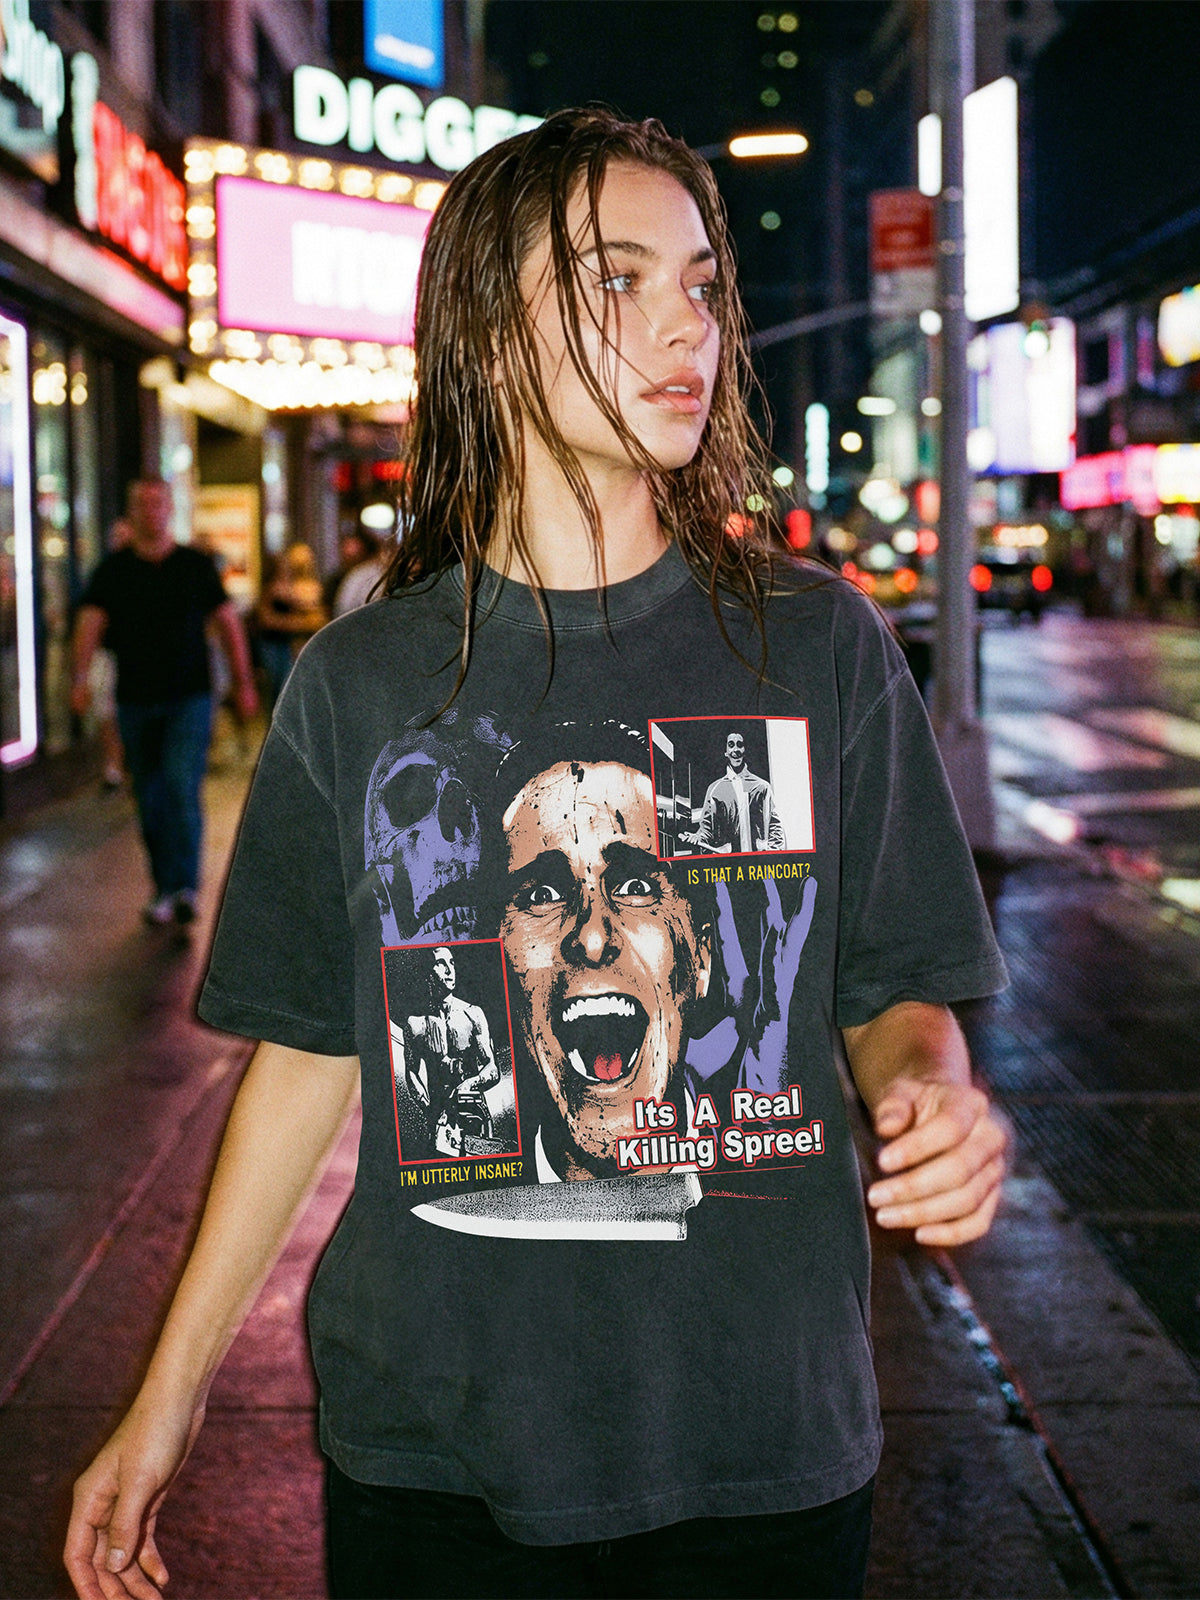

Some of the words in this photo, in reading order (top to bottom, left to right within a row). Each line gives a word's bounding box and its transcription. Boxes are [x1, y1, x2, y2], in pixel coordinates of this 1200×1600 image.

[687, 869, 700, 885] IS
[703, 866, 732, 883] THAT
[736, 866, 745, 881] A
[748, 863, 811, 881] RAINCOAT?
[634, 1098, 676, 1129] Its
[694, 1096, 719, 1126] A
[731, 1087, 801, 1121] Real
[618, 1135, 715, 1167] Killing
[723, 1122, 823, 1164] Spree!
[400, 1171, 418, 1187] I'M
[422, 1166, 471, 1185] UTTERLY
[475, 1161, 523, 1180] INSANE?
